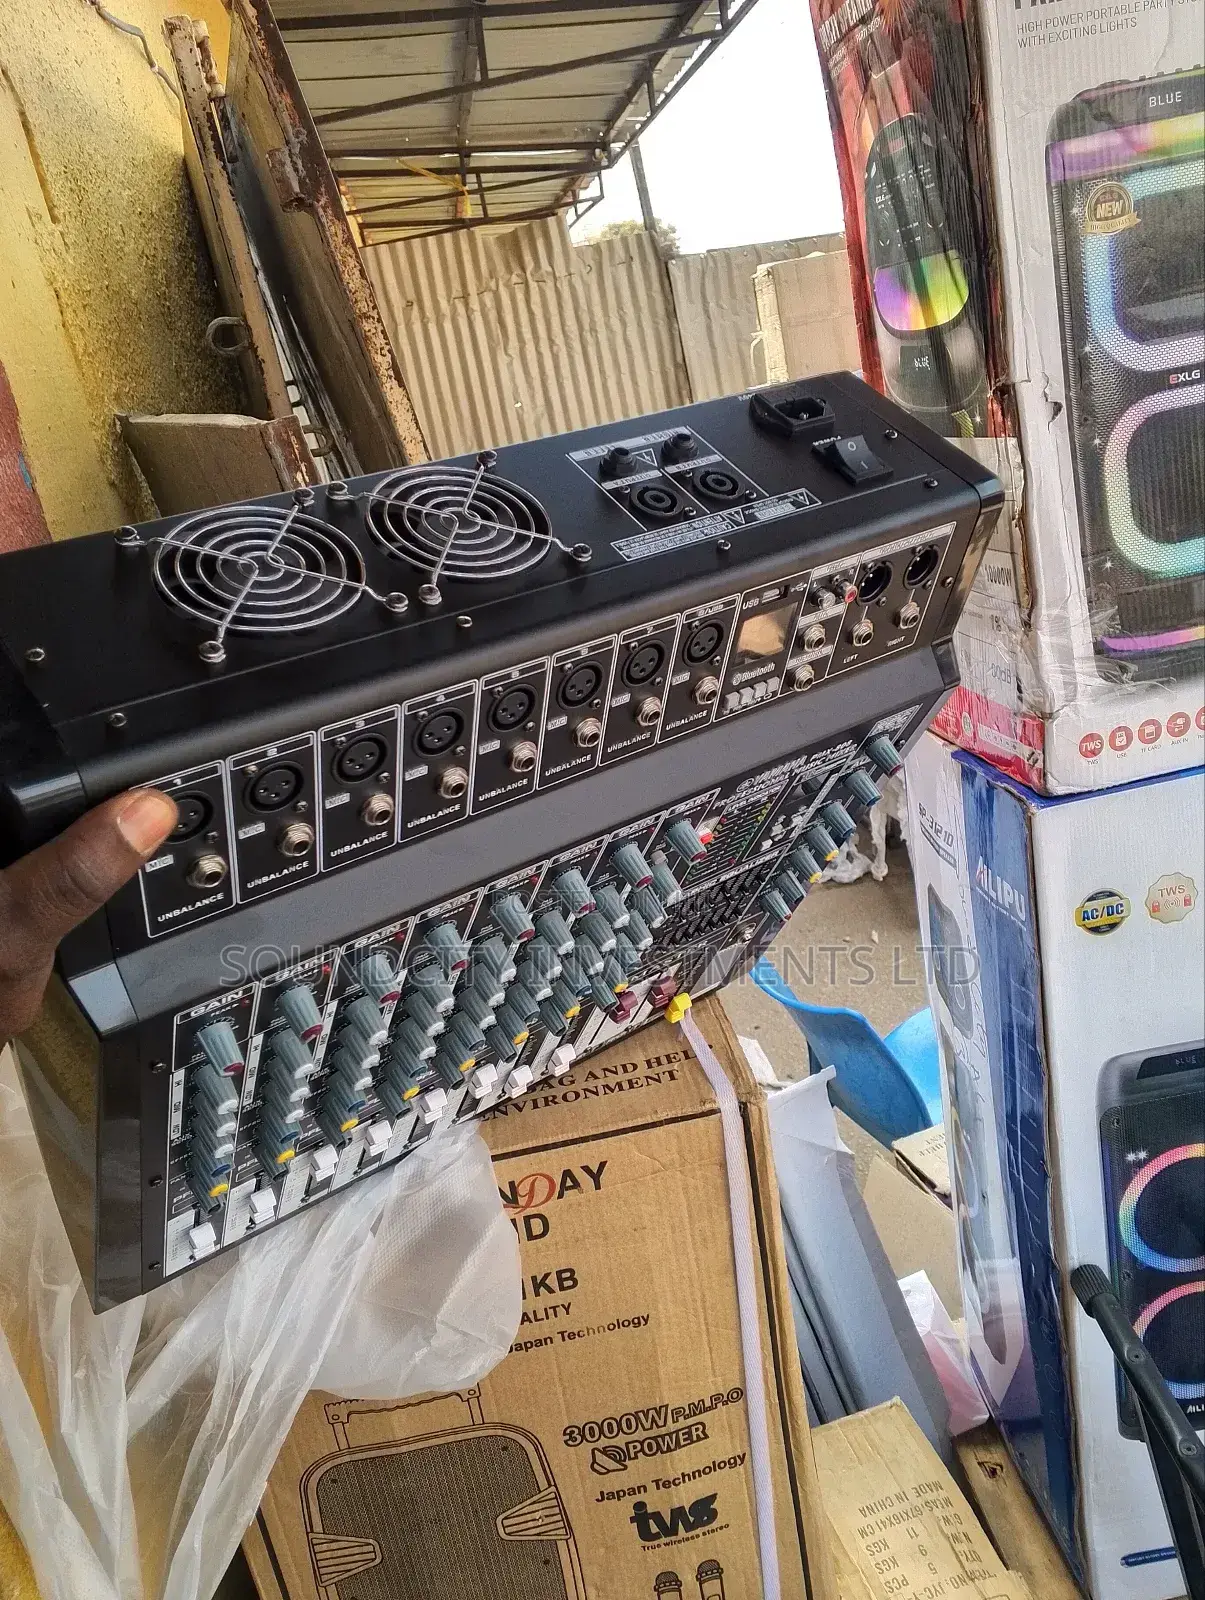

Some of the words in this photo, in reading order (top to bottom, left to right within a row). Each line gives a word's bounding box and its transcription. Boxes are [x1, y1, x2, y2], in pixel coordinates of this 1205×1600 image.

[1017, 20, 1043, 34] HIGH
[1046, 13, 1084, 29] POWER
[1086, 1, 1141, 22] PORTABLE
[1017, 33, 1046, 48] WITH
[1048, 24, 1097, 43] EXCITING
[1100, 17, 1137, 33] LIGHTS
[1149, 91, 1183, 107] BLUE
[1096, 200, 1124, 218] NEW
[1170, 370, 1201, 384] EXLG
[742, 597, 760, 610] USB
[843, 653, 859, 664] LEFT
[666, 710, 708, 731] UNBALANCE
[607, 732, 651, 753] UNBALANCE
[1082, 740, 1102, 752] TWS
[545, 754, 592, 777] UNBALANCE
[713, 773, 790, 809] PROFESSIONAL
[791, 758, 824, 776] MUSIC
[825, 744, 858, 763] MIXER
[479, 778, 529, 801] UNBALANCE
[675, 794, 711, 813] GAIN
[407, 804, 461, 829] UNBALANCE
[618, 817, 656, 837] GAIN
[330, 831, 389, 857] UNBALANCE
[558, 840, 598, 862] GAIN
[147, 855, 173, 871] MIC
[247, 860, 309, 888] UNBALANCE
[496, 867, 537, 888] GAIN
[1158, 884, 1186, 898] TWS
[157, 892, 224, 922] UNBALANCE
[427, 894, 472, 917] GAIN
[1081, 903, 1125, 922] AC/DC
[354, 924, 401, 948] GAIN
[275, 955, 325, 981] GAIN
[190, 990, 243, 1017] GAIN
[584, 1061, 638, 1083] AND
[646, 1045, 712, 1070] HEL
[520, 1302, 572, 1325] ALITY
[557, 1313, 650, 1343] Technology
[563, 1404, 669, 1447] 3000W
[627, 1421, 710, 1461] POWER
[595, 1484, 648, 1503] Japan
[651, 1452, 748, 1491] Technology
[895, 1491, 910, 1502] IN
[911, 1480, 944, 1498] MADE
[858, 1496, 894, 1518] CHINA
[629, 1493, 719, 1543] tws
[640, 1543, 662, 1552] True
[663, 1533, 700, 1549] wireless
[701, 1523, 730, 1537] stereo
[857, 1527, 876, 1539] CM
[906, 1526, 919, 1539] 11
[865, 1537, 890, 1557] KGS
[918, 1544, 928, 1556] 9
[874, 1555, 900, 1575] KGS
[927, 1562, 938, 1575] 5
[884, 1574, 910, 1594] PCS
